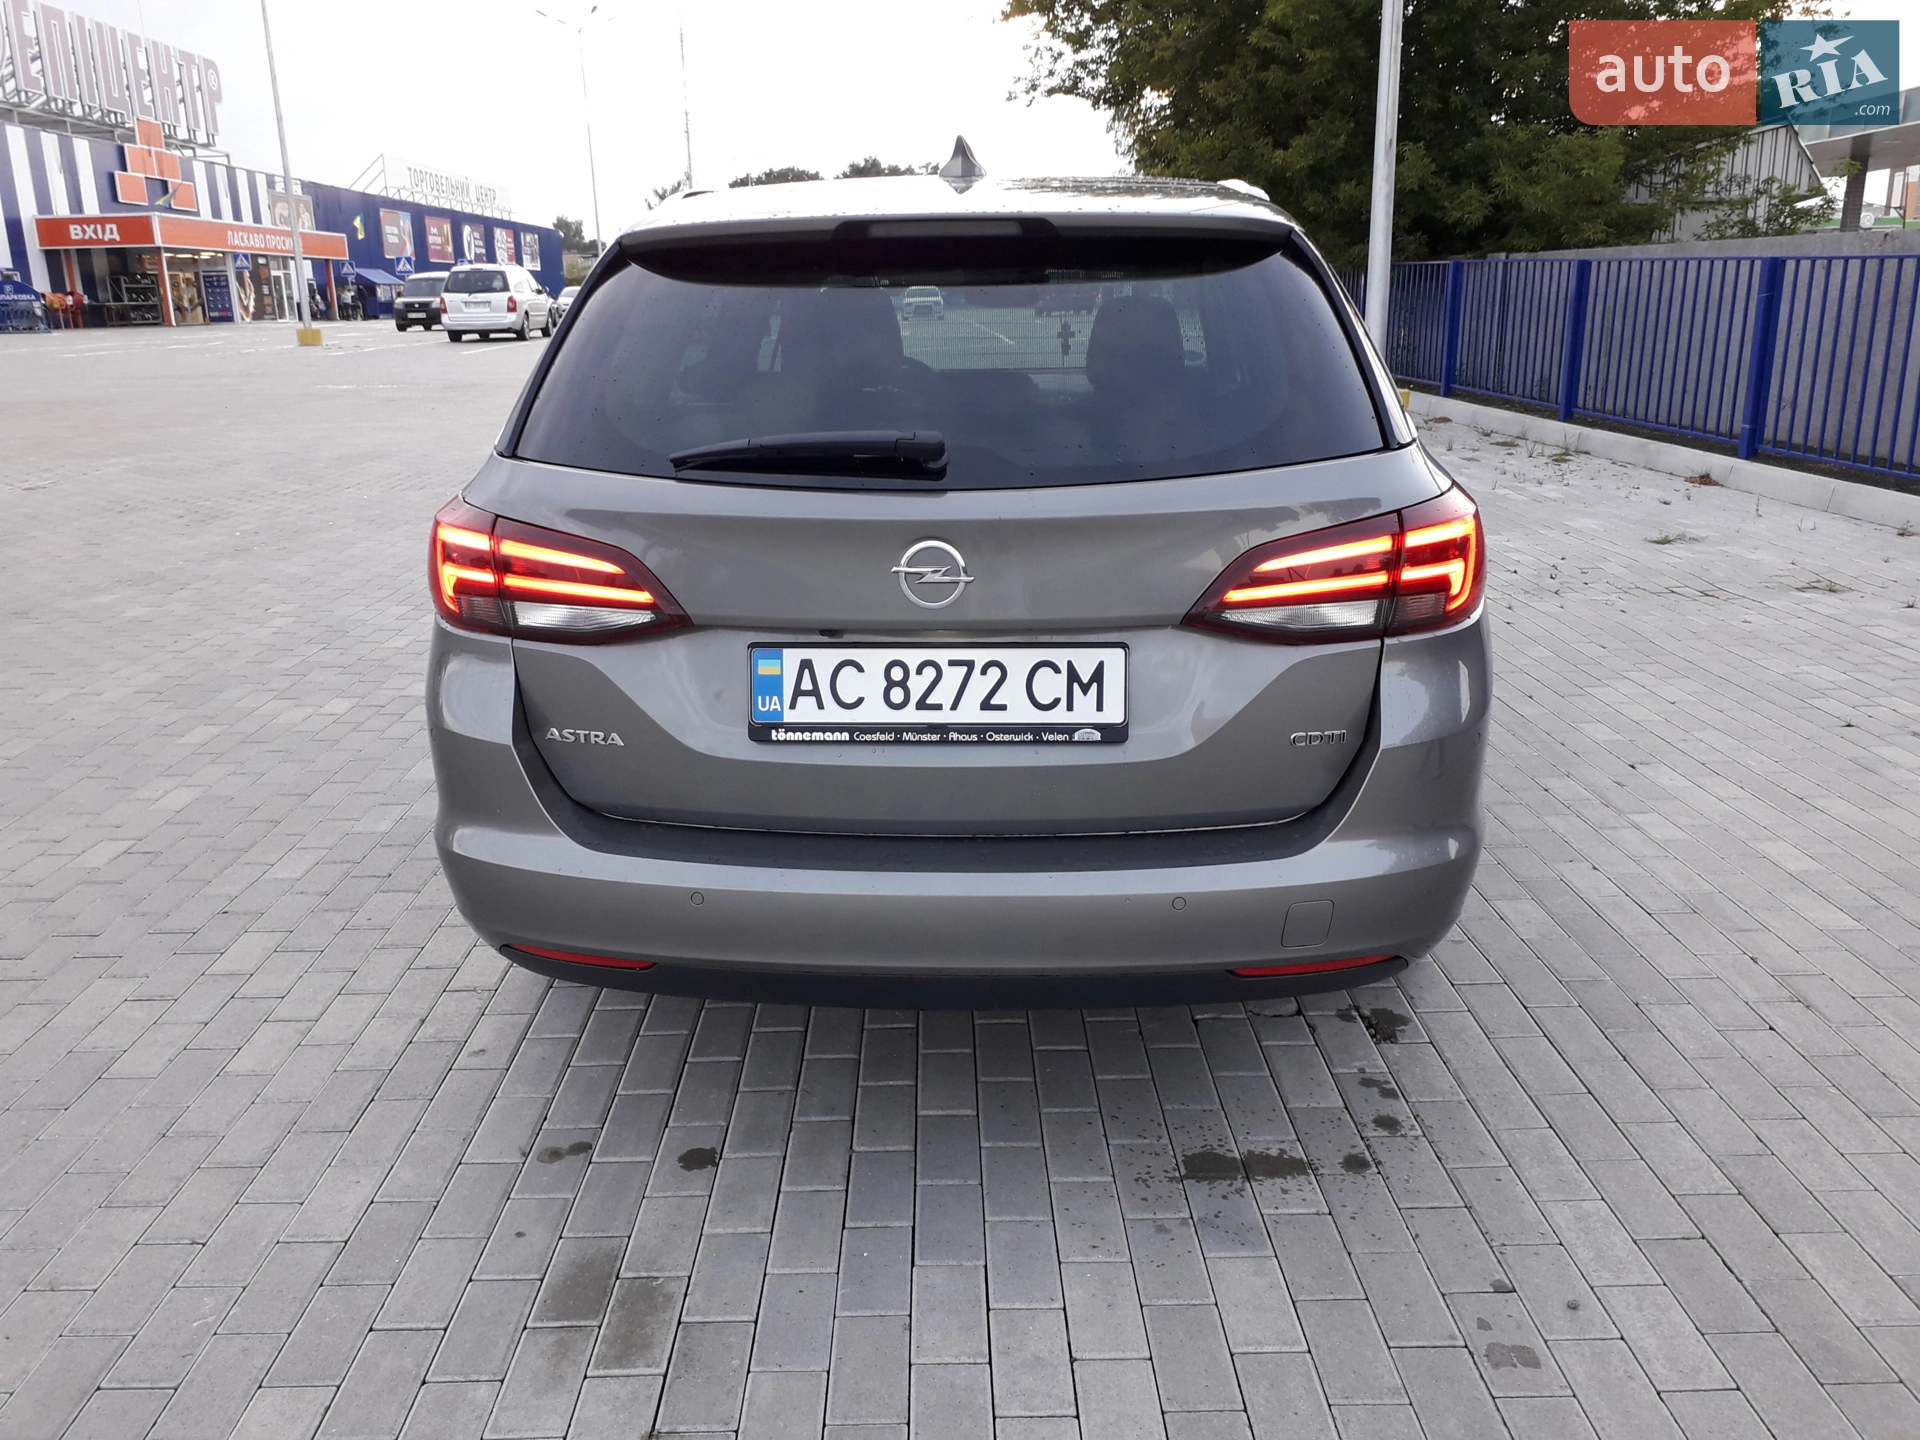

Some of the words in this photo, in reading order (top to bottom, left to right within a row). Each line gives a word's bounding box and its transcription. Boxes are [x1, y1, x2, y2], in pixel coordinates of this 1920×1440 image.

[407, 166, 471, 200] ТОРГОВЕЛЬНИЙ
[475, 184, 497, 205] ЦЕНТР
[69, 223, 120, 241] ВХІД
[227, 230, 265, 248] ЛАСКАВО
[266, 234, 303, 252] ПРОСИМ
[788, 658, 866, 711] AC
[883, 659, 1008, 711] 8272
[1026, 659, 1104, 712] CM
[758, 696, 781, 712] UA
[545, 727, 625, 747] ASTRA
[771, 729, 849, 741] tönnemann
[853, 731, 894, 741] Coesfeld
[902, 731, 941, 741] Münster
[949, 731, 978, 741] Ahaus
[985, 731, 1033, 741] Osterwick
[1041, 731, 1069, 741] Velen
[1290, 729, 1347, 747] CDTI
